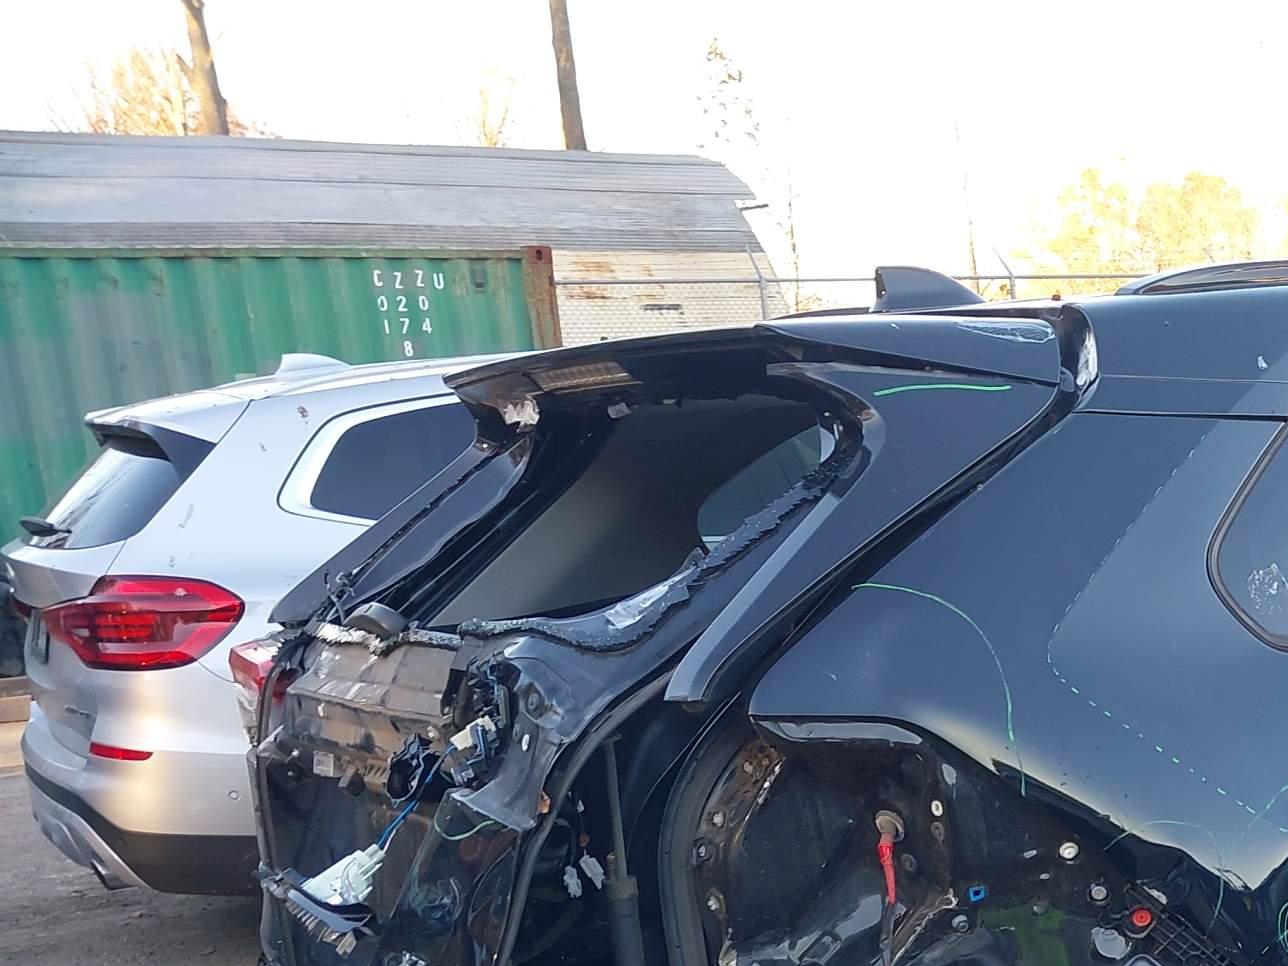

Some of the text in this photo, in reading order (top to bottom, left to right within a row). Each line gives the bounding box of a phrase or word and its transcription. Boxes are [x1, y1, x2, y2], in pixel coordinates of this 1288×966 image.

[373, 269, 445, 290] CZZU
[377, 295, 430, 312] 020
[384, 317, 433, 335] 174
[403, 340, 414, 357] 8
